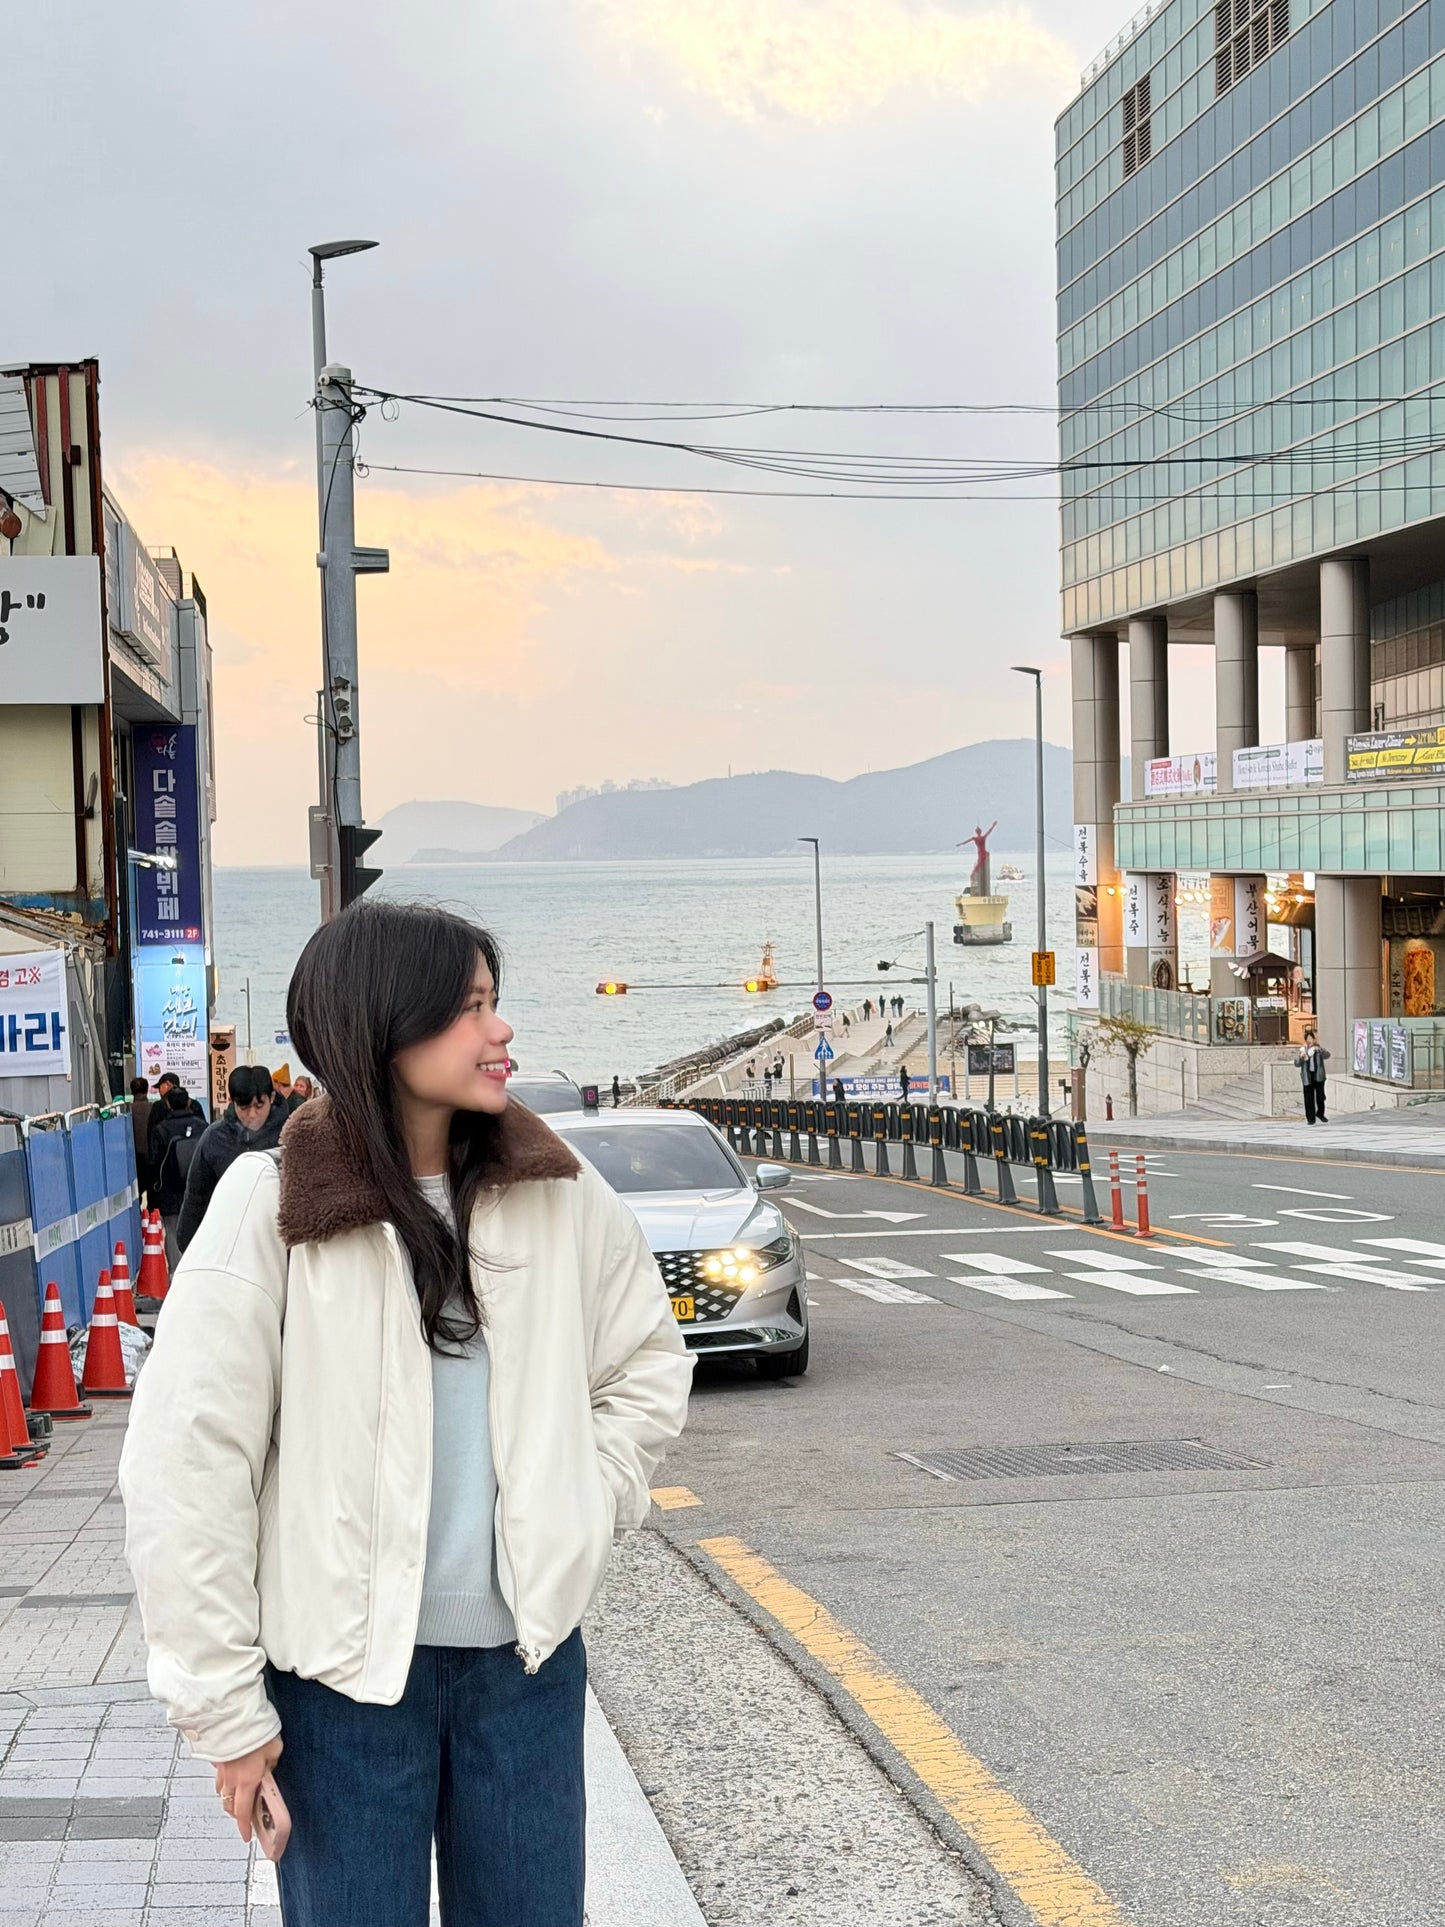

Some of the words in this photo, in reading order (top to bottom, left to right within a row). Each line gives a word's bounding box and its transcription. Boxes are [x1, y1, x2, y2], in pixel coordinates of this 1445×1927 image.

[1245, 883, 1259, 949] 부산어묵
[142, 930, 184, 939] 741-3111
[187, 929, 198, 938] 2F
[1169, 1207, 1395, 1228] 30
